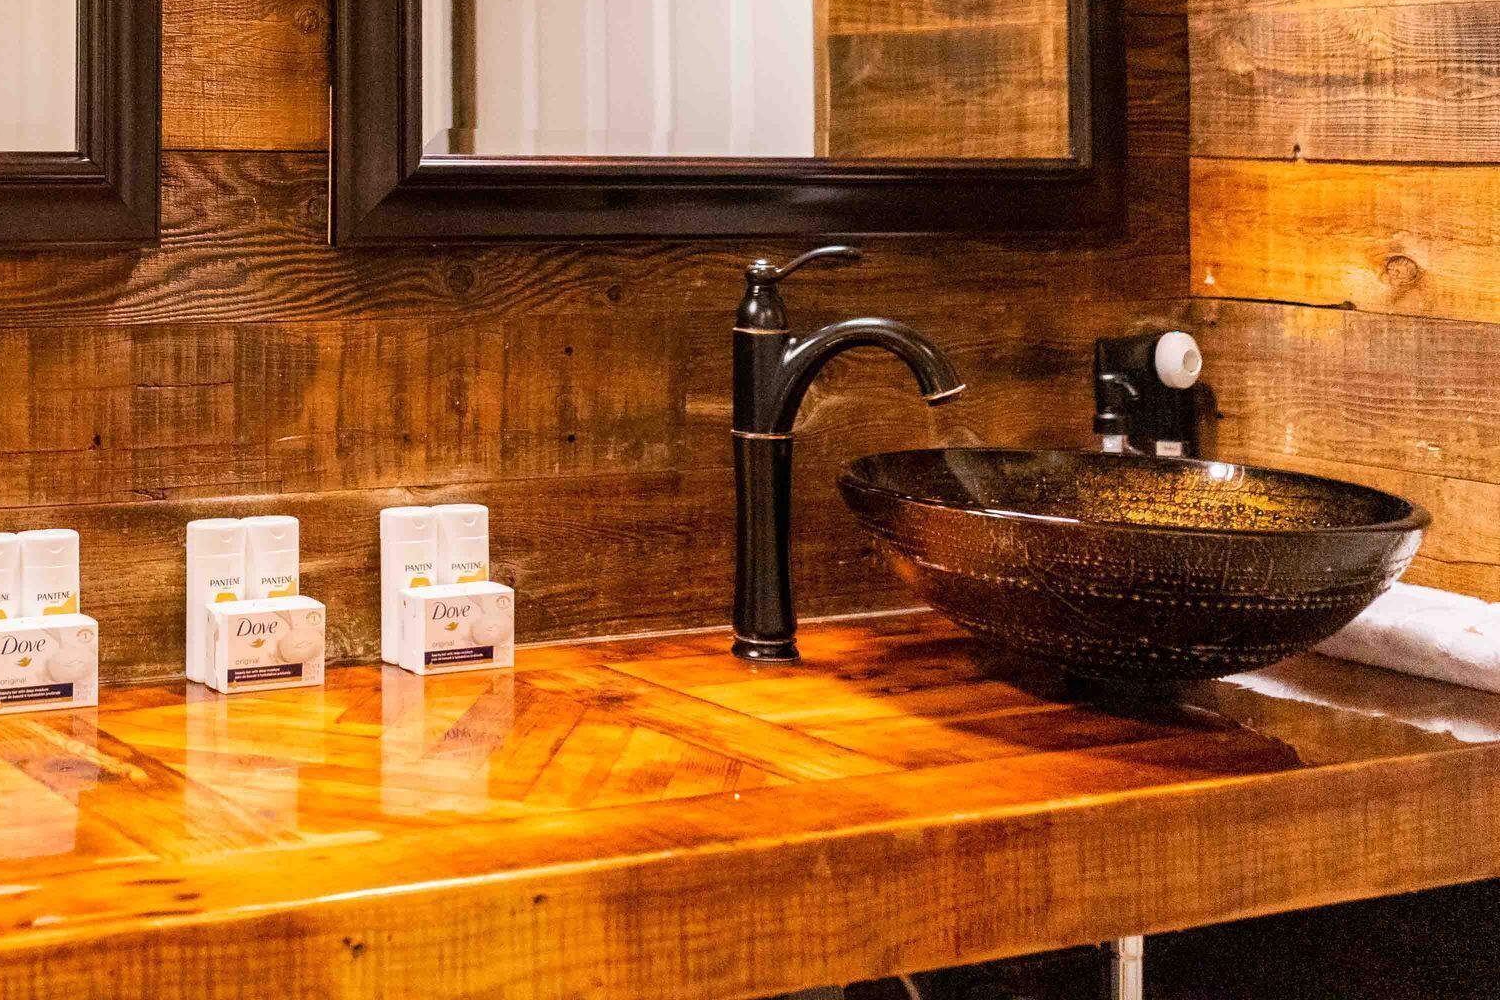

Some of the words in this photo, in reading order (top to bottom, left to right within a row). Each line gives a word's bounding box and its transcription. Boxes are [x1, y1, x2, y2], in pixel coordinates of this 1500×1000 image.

[405, 562, 432, 572] PANTENE
[451, 561, 481, 570] PANTENE
[210, 577, 239, 586] PANTENE
[261, 575, 292, 584] PANTENE
[37, 591, 70, 600] PANTENE
[432, 601, 470, 620] Dove
[236, 617, 278, 637] Dove
[1, 635, 46, 655] Dove
[235, 657, 260, 667] original
[0, 677, 27, 687] original
